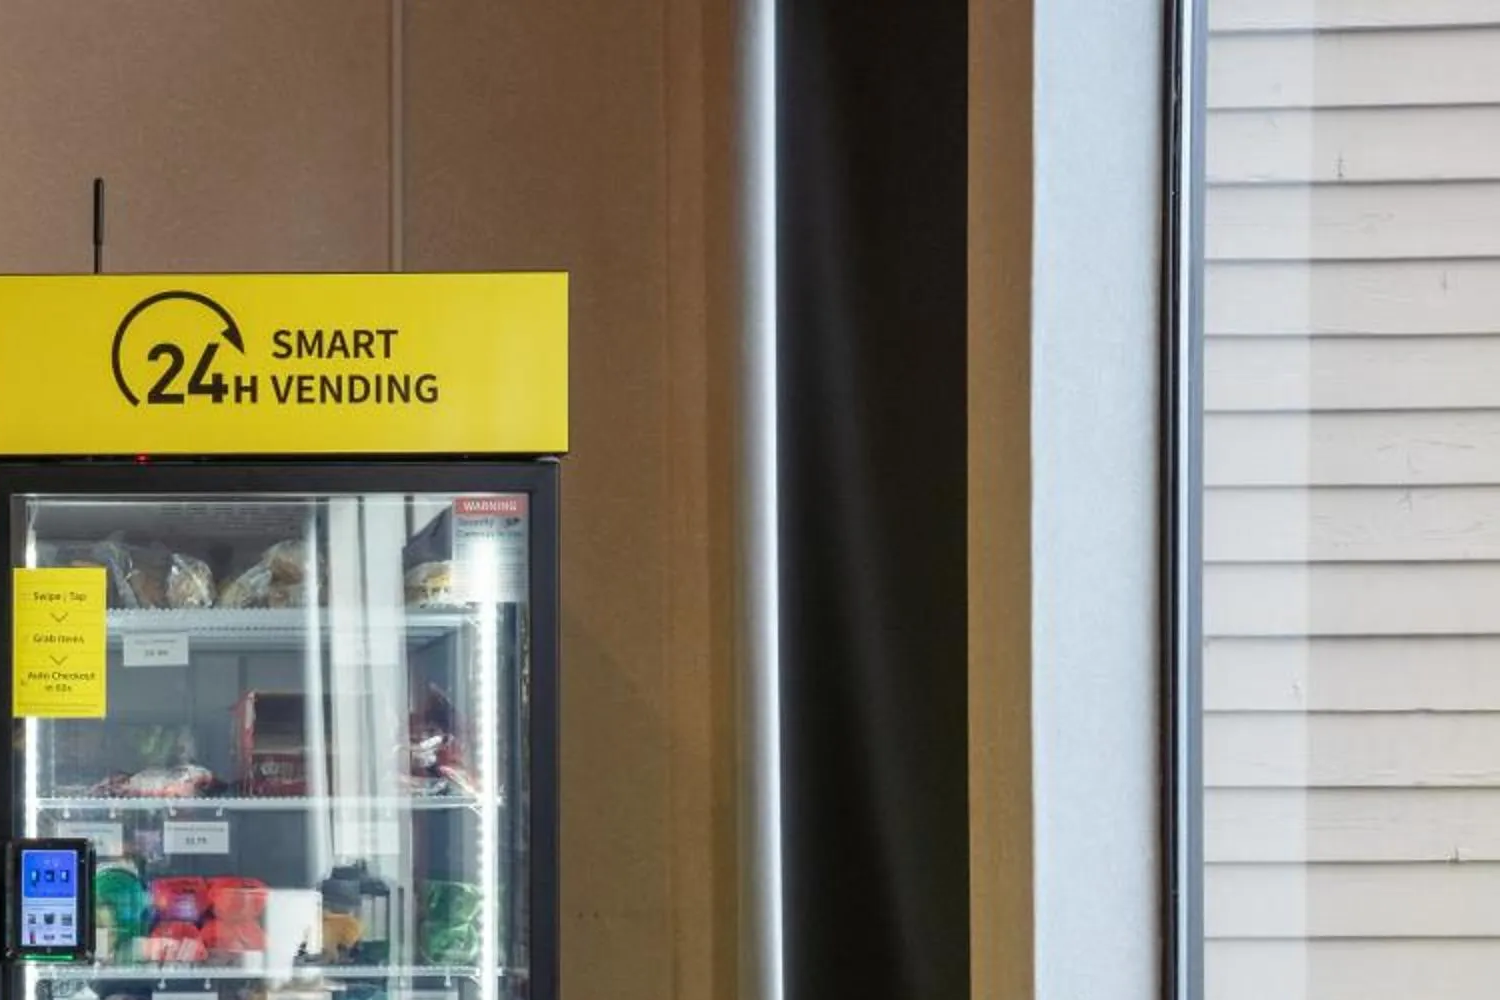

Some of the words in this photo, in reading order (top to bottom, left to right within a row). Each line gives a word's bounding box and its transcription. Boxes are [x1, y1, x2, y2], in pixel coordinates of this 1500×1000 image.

[272, 329, 399, 360] SMART
[270, 374, 438, 405] VENDING
[33, 592, 61, 602] Swipe
[33, 633, 56, 643] Grab
